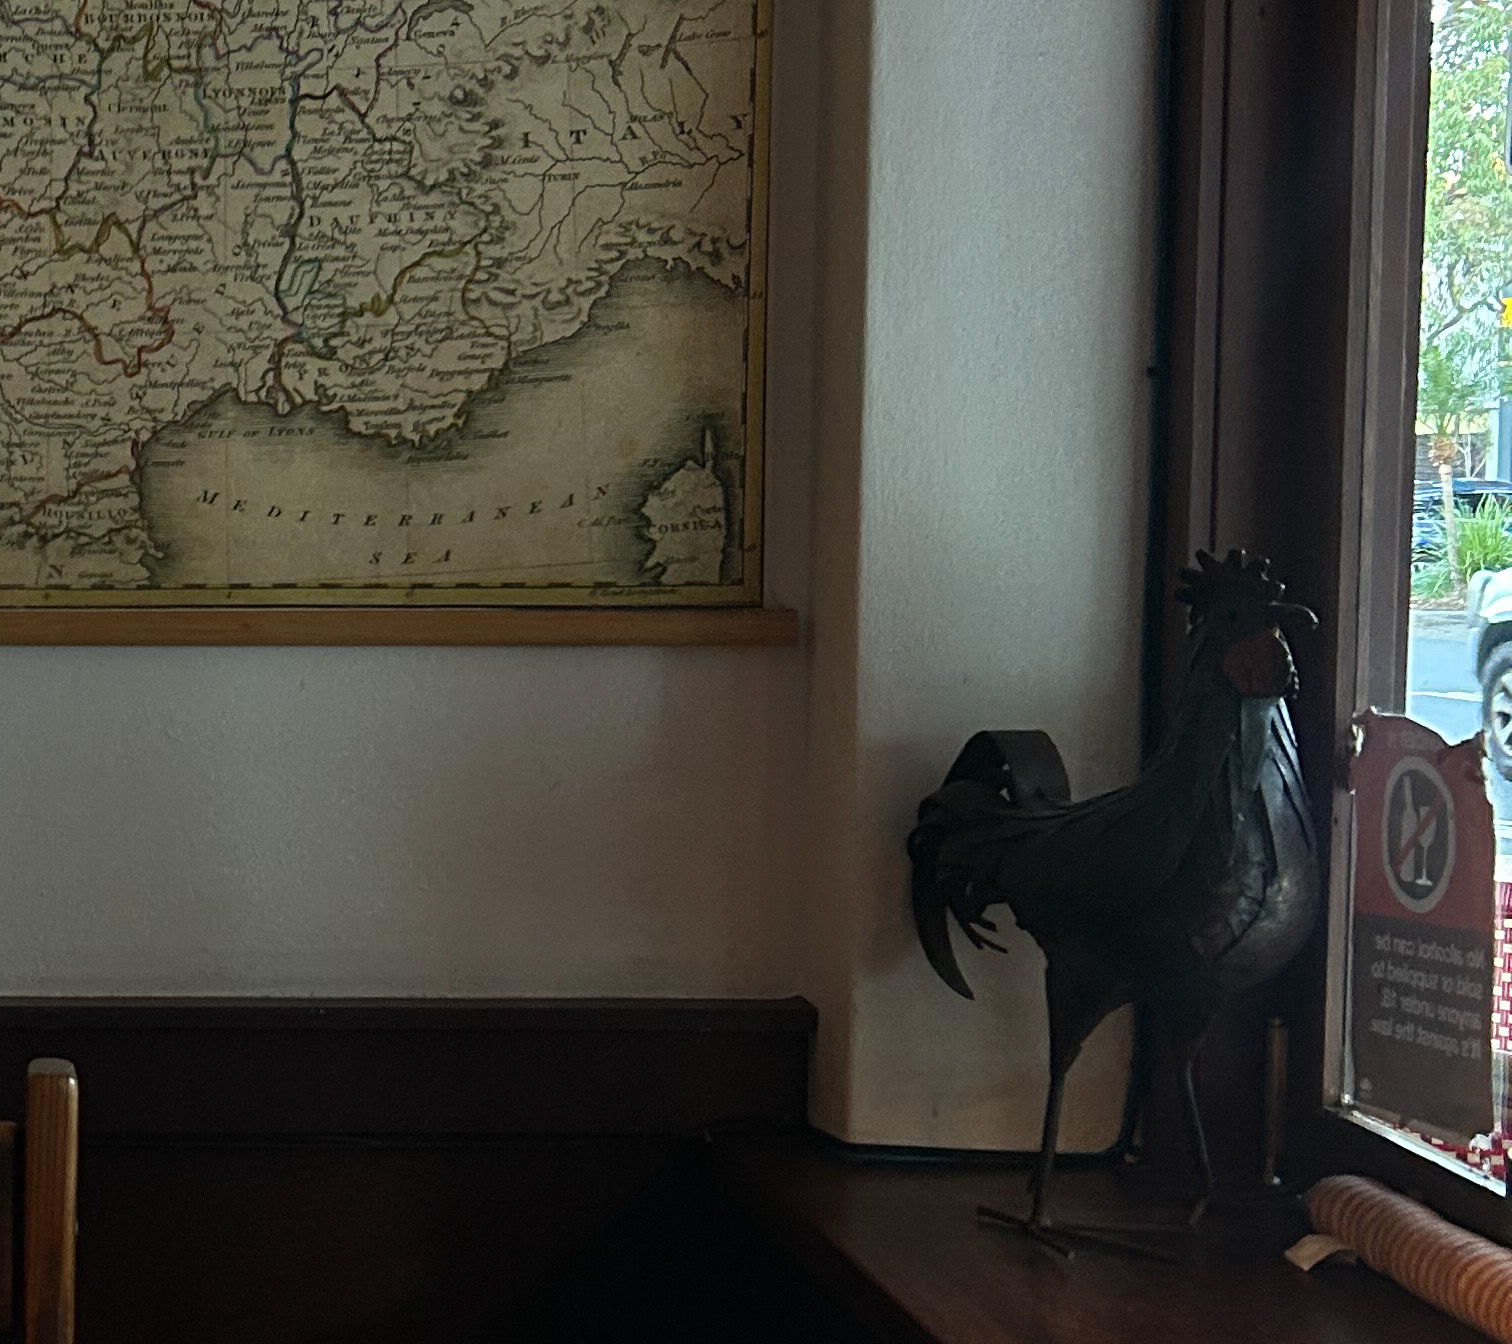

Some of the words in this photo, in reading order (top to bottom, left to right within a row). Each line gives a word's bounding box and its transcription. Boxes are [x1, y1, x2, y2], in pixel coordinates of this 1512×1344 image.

[413, 28, 456, 40] Geneva
[521, 112, 750, 150] ITALY
[547, 172, 582, 183] TURIN
[196, 426, 235, 440] GULF
[241, 428, 260, 439] OF
[268, 425, 316, 437] LYONS
[368, 547, 452, 566] SEA
